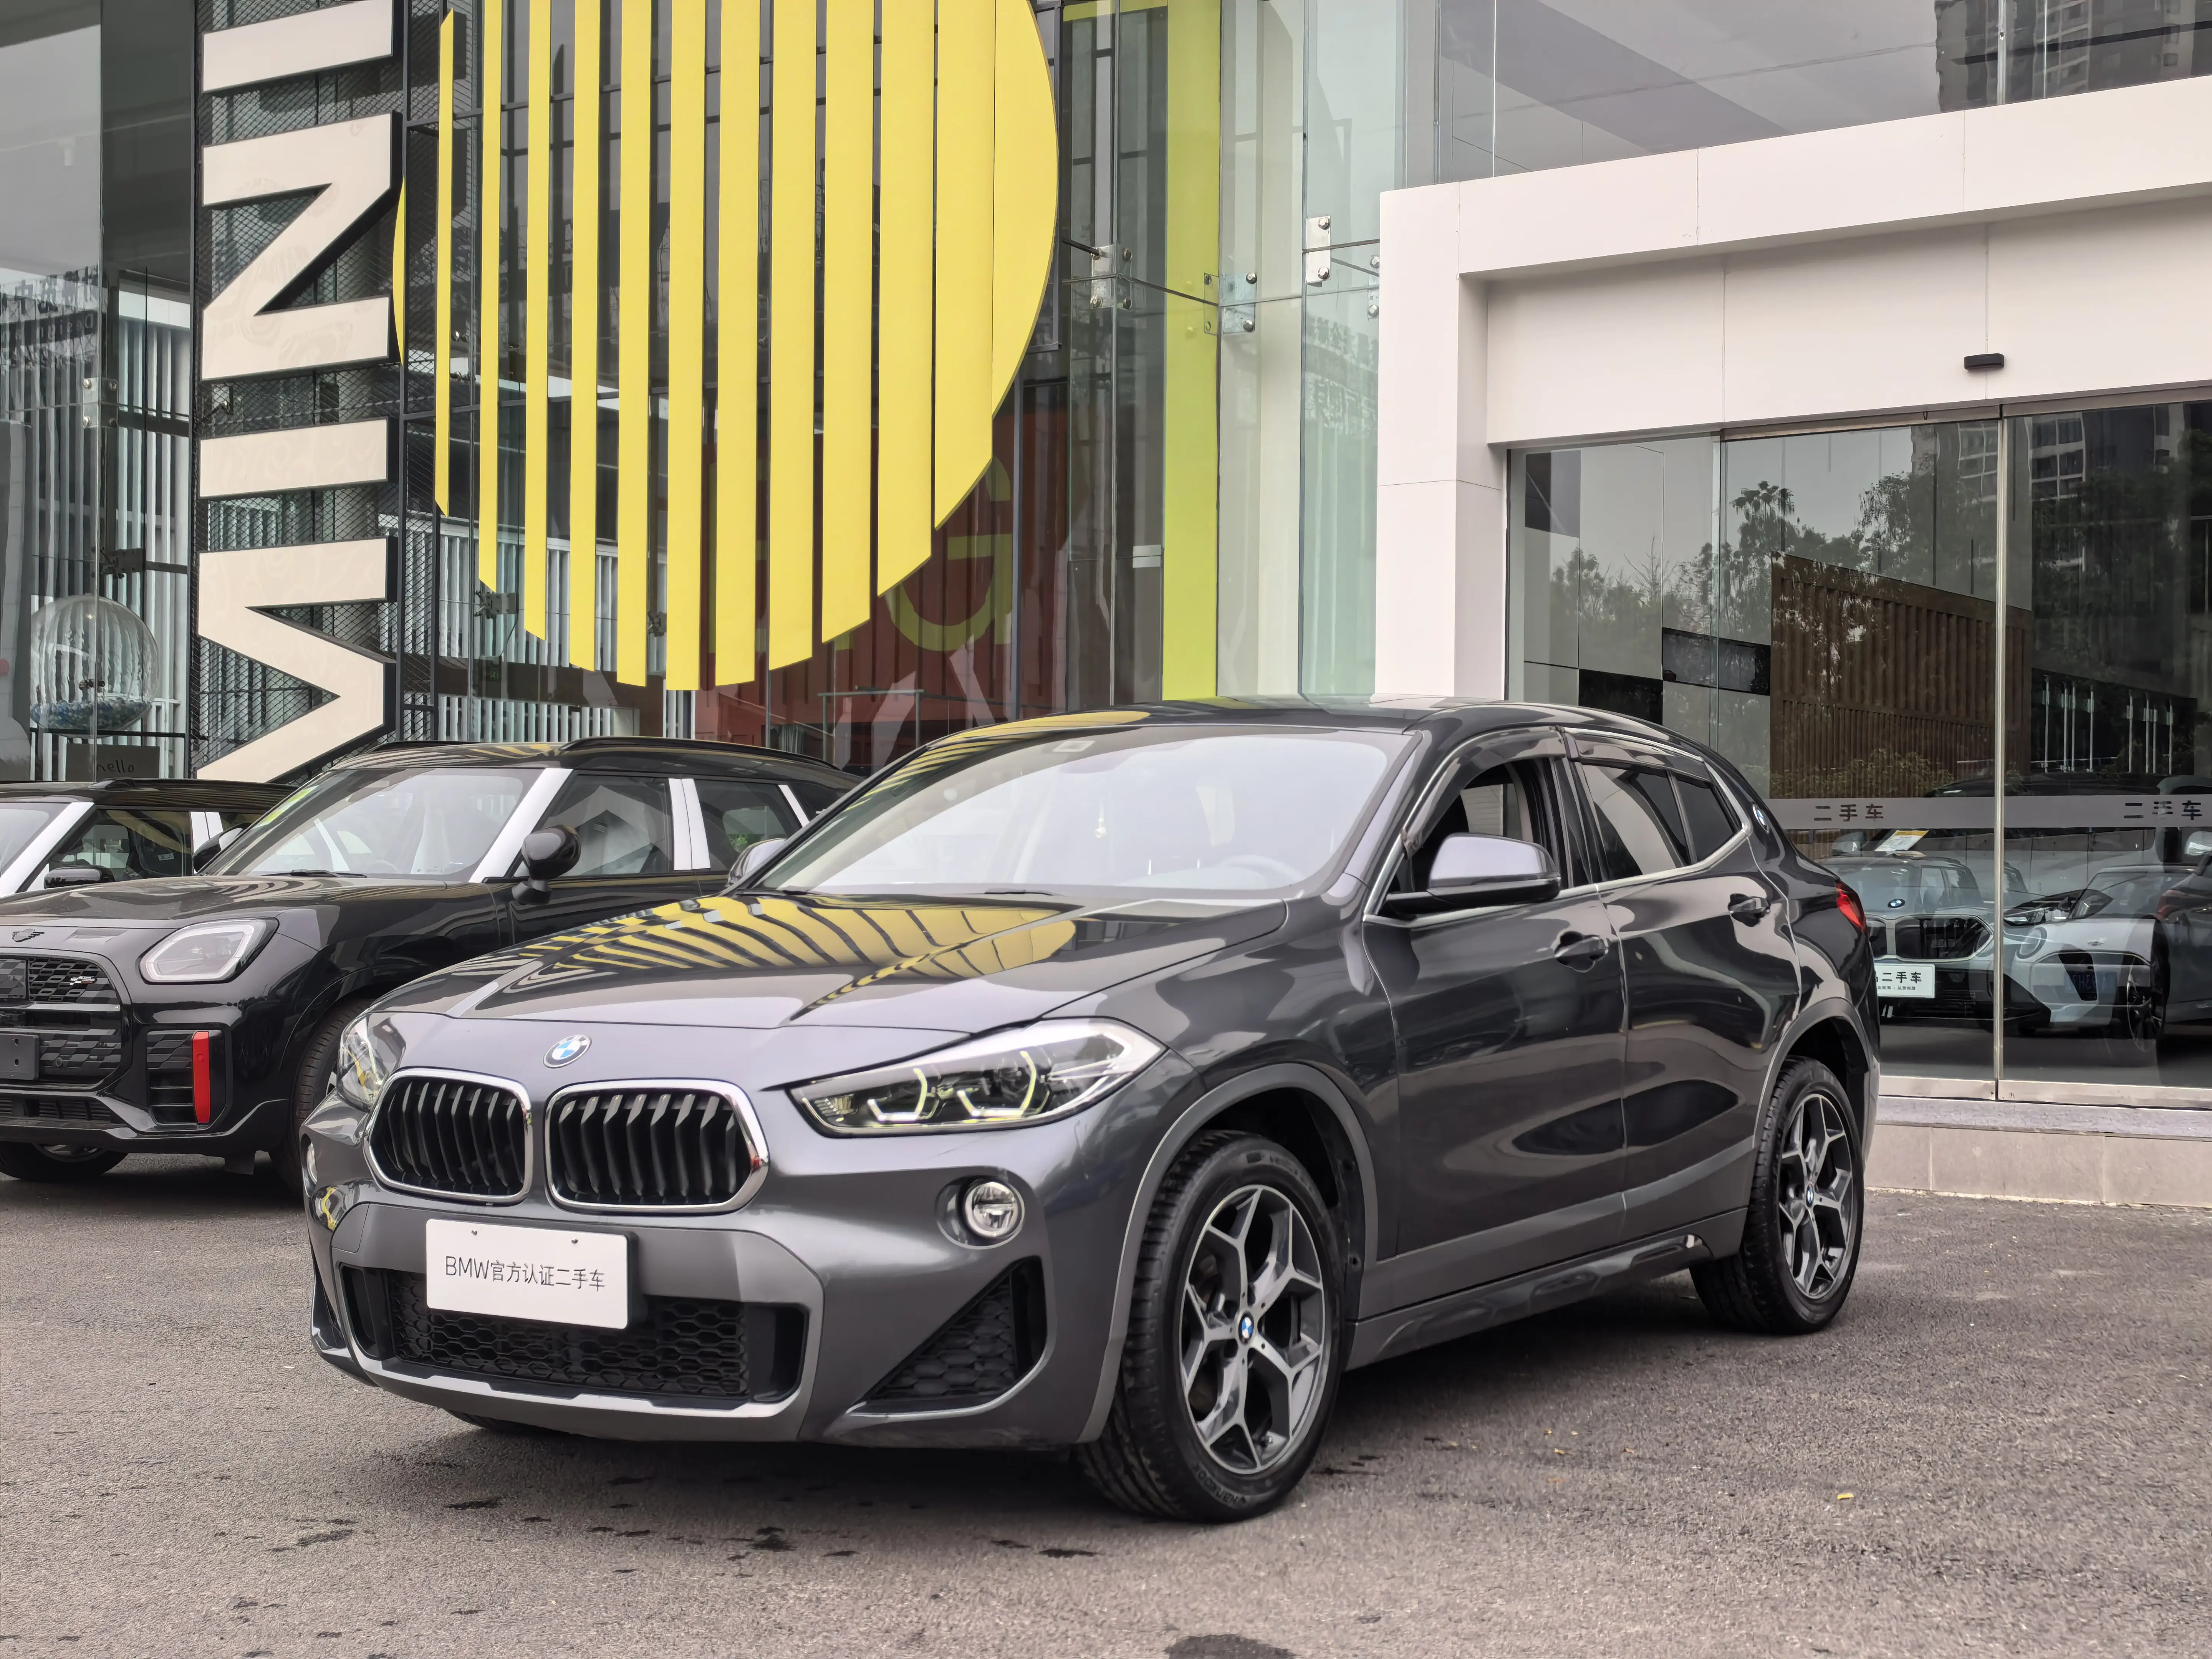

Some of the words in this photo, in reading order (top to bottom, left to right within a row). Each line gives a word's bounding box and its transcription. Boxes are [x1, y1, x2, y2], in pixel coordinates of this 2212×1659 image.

[197, 0, 393, 784] MINI
[1813, 803, 1884, 822] 二手车
[2123, 800, 2203, 821] 二手车
[1875, 971, 1922, 984] 二手车
[445, 1255, 606, 1292] BMW官方认证二手车
